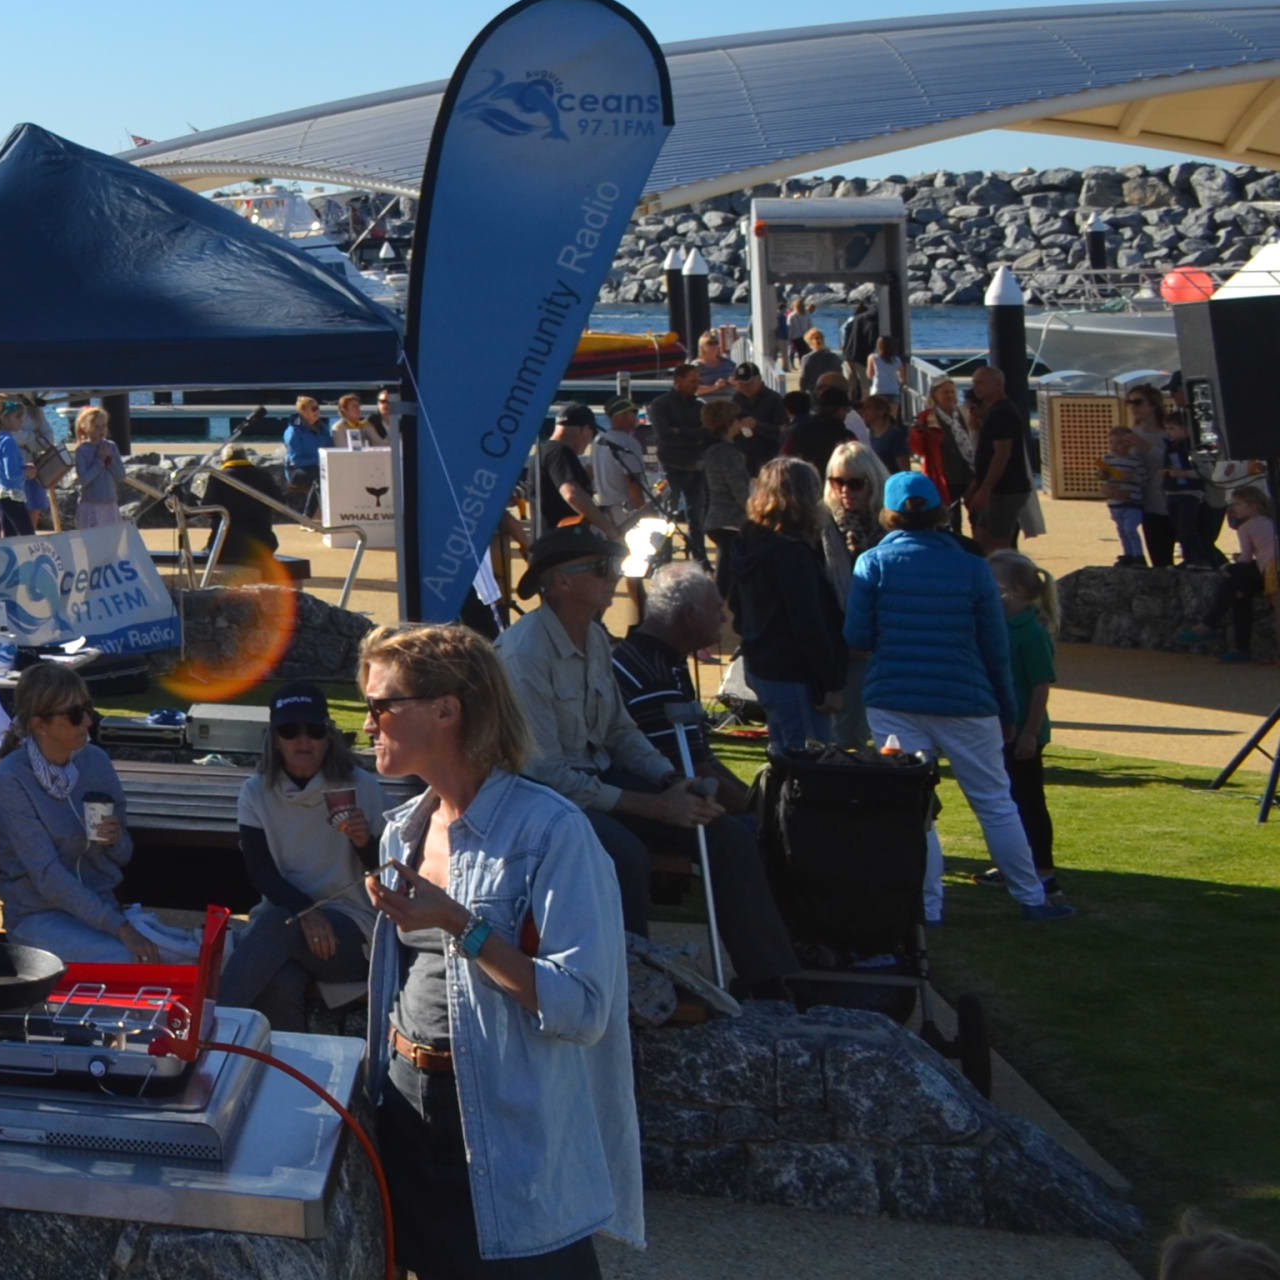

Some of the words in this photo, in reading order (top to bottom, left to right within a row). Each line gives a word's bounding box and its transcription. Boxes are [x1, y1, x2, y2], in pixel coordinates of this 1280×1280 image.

[422, 467, 501, 601] Augusta
[479, 279, 582, 459] Community
[556, 180, 621, 274] Radio
[339, 512, 379, 521] WHALE
[127, 626, 176, 648] Radio
